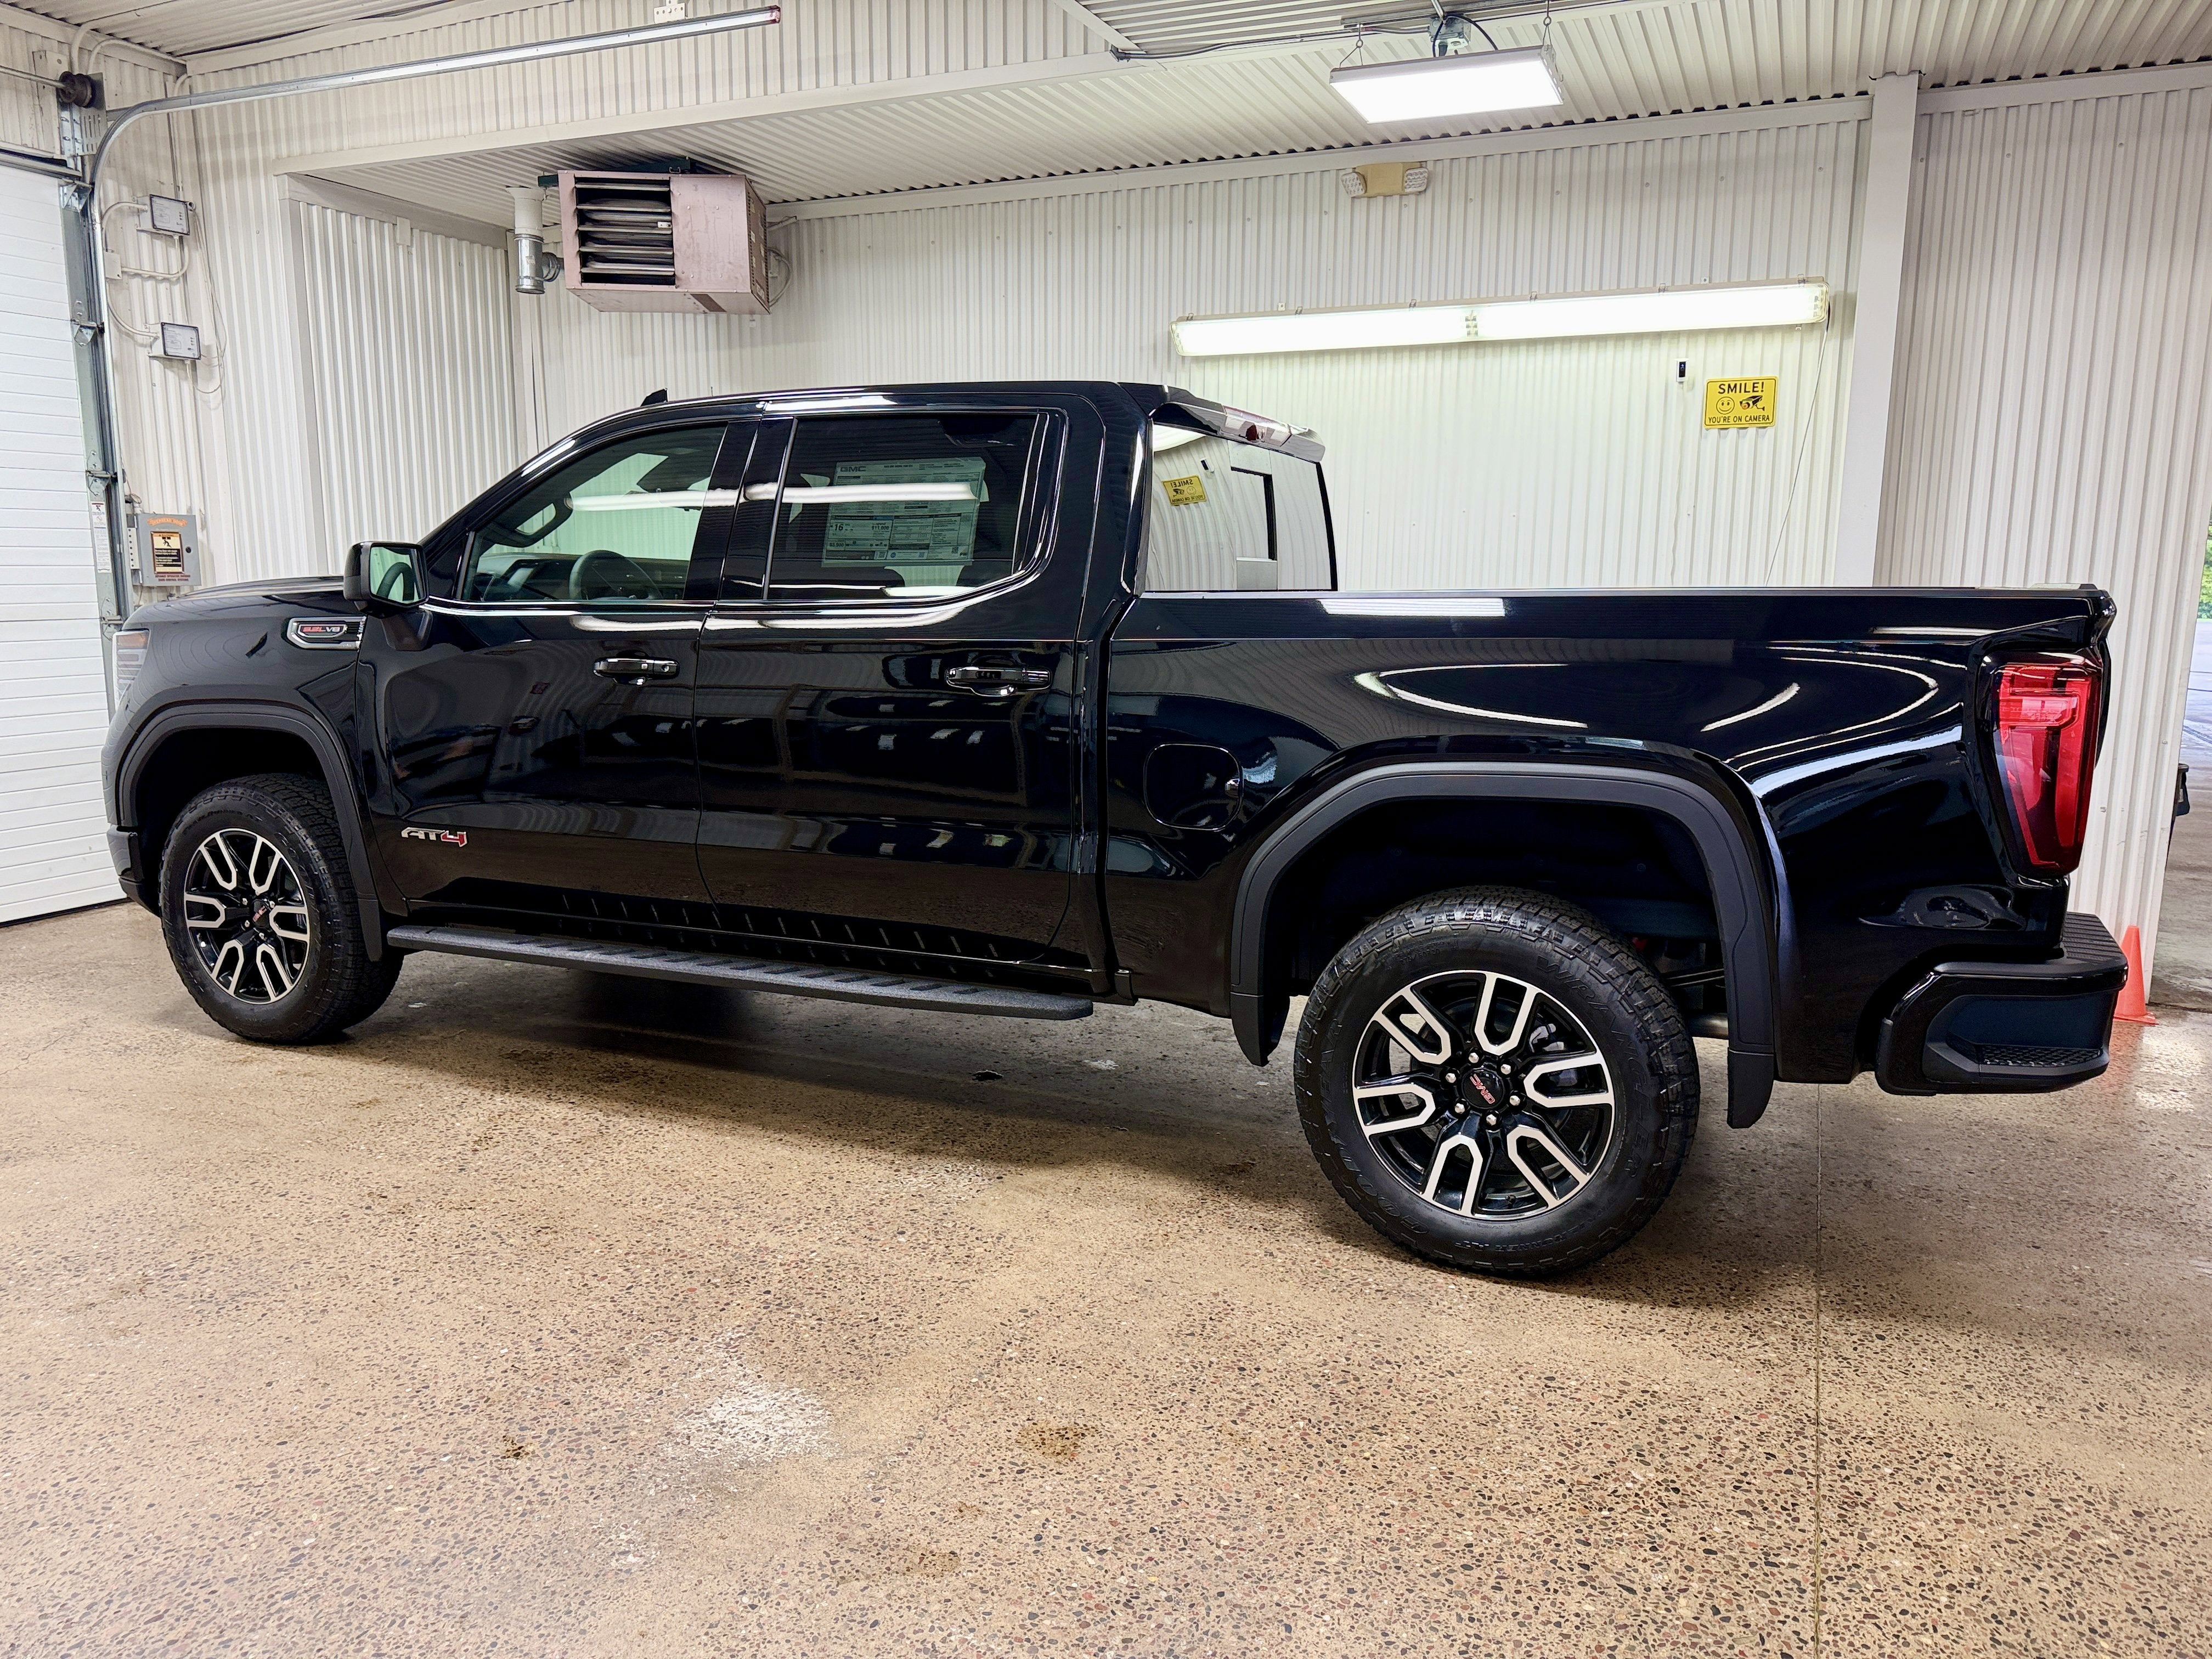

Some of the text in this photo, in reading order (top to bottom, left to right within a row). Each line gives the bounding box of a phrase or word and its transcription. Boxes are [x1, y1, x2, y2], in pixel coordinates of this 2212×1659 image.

[1718, 381, 1764, 394] SMILE!
[1708, 414, 1770, 424] YOU'RE ON CAMERA
[400, 826, 468, 848] AT4
[1469, 1073, 1496, 1104] GMC
[1319, 1018, 1430, 1234] GOODYEAR
